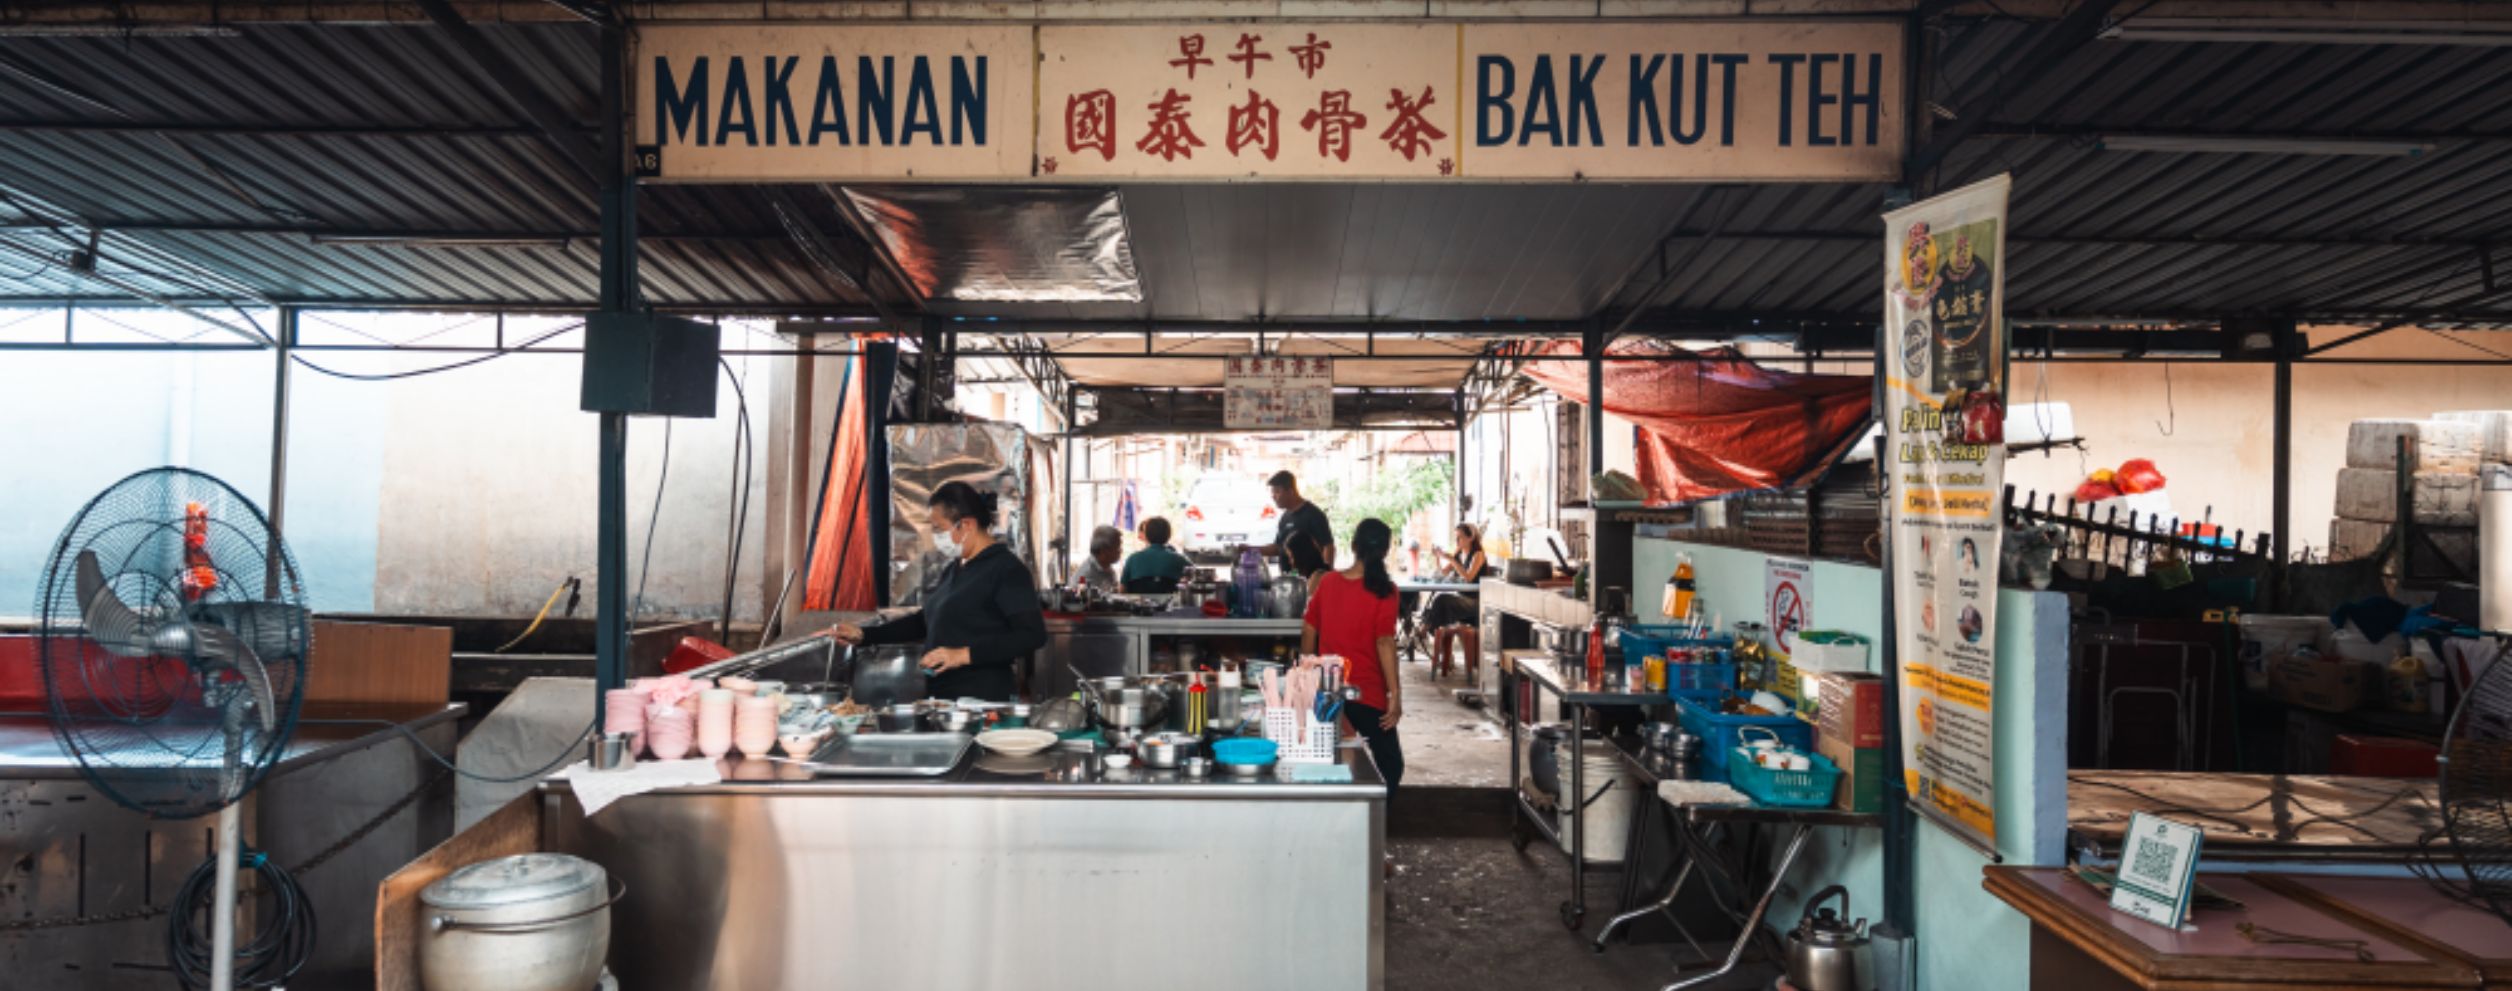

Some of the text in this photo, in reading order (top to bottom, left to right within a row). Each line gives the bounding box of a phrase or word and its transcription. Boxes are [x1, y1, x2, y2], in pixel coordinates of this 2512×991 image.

[1168, 32, 1333, 80] 早午市
[654, 54, 988, 147] MAKANAN
[1065, 85, 1448, 162] 國泰肉骨茶
[1476, 53, 1882, 148] BAK KUT TEH
[1900, 403, 1943, 433] Palin
